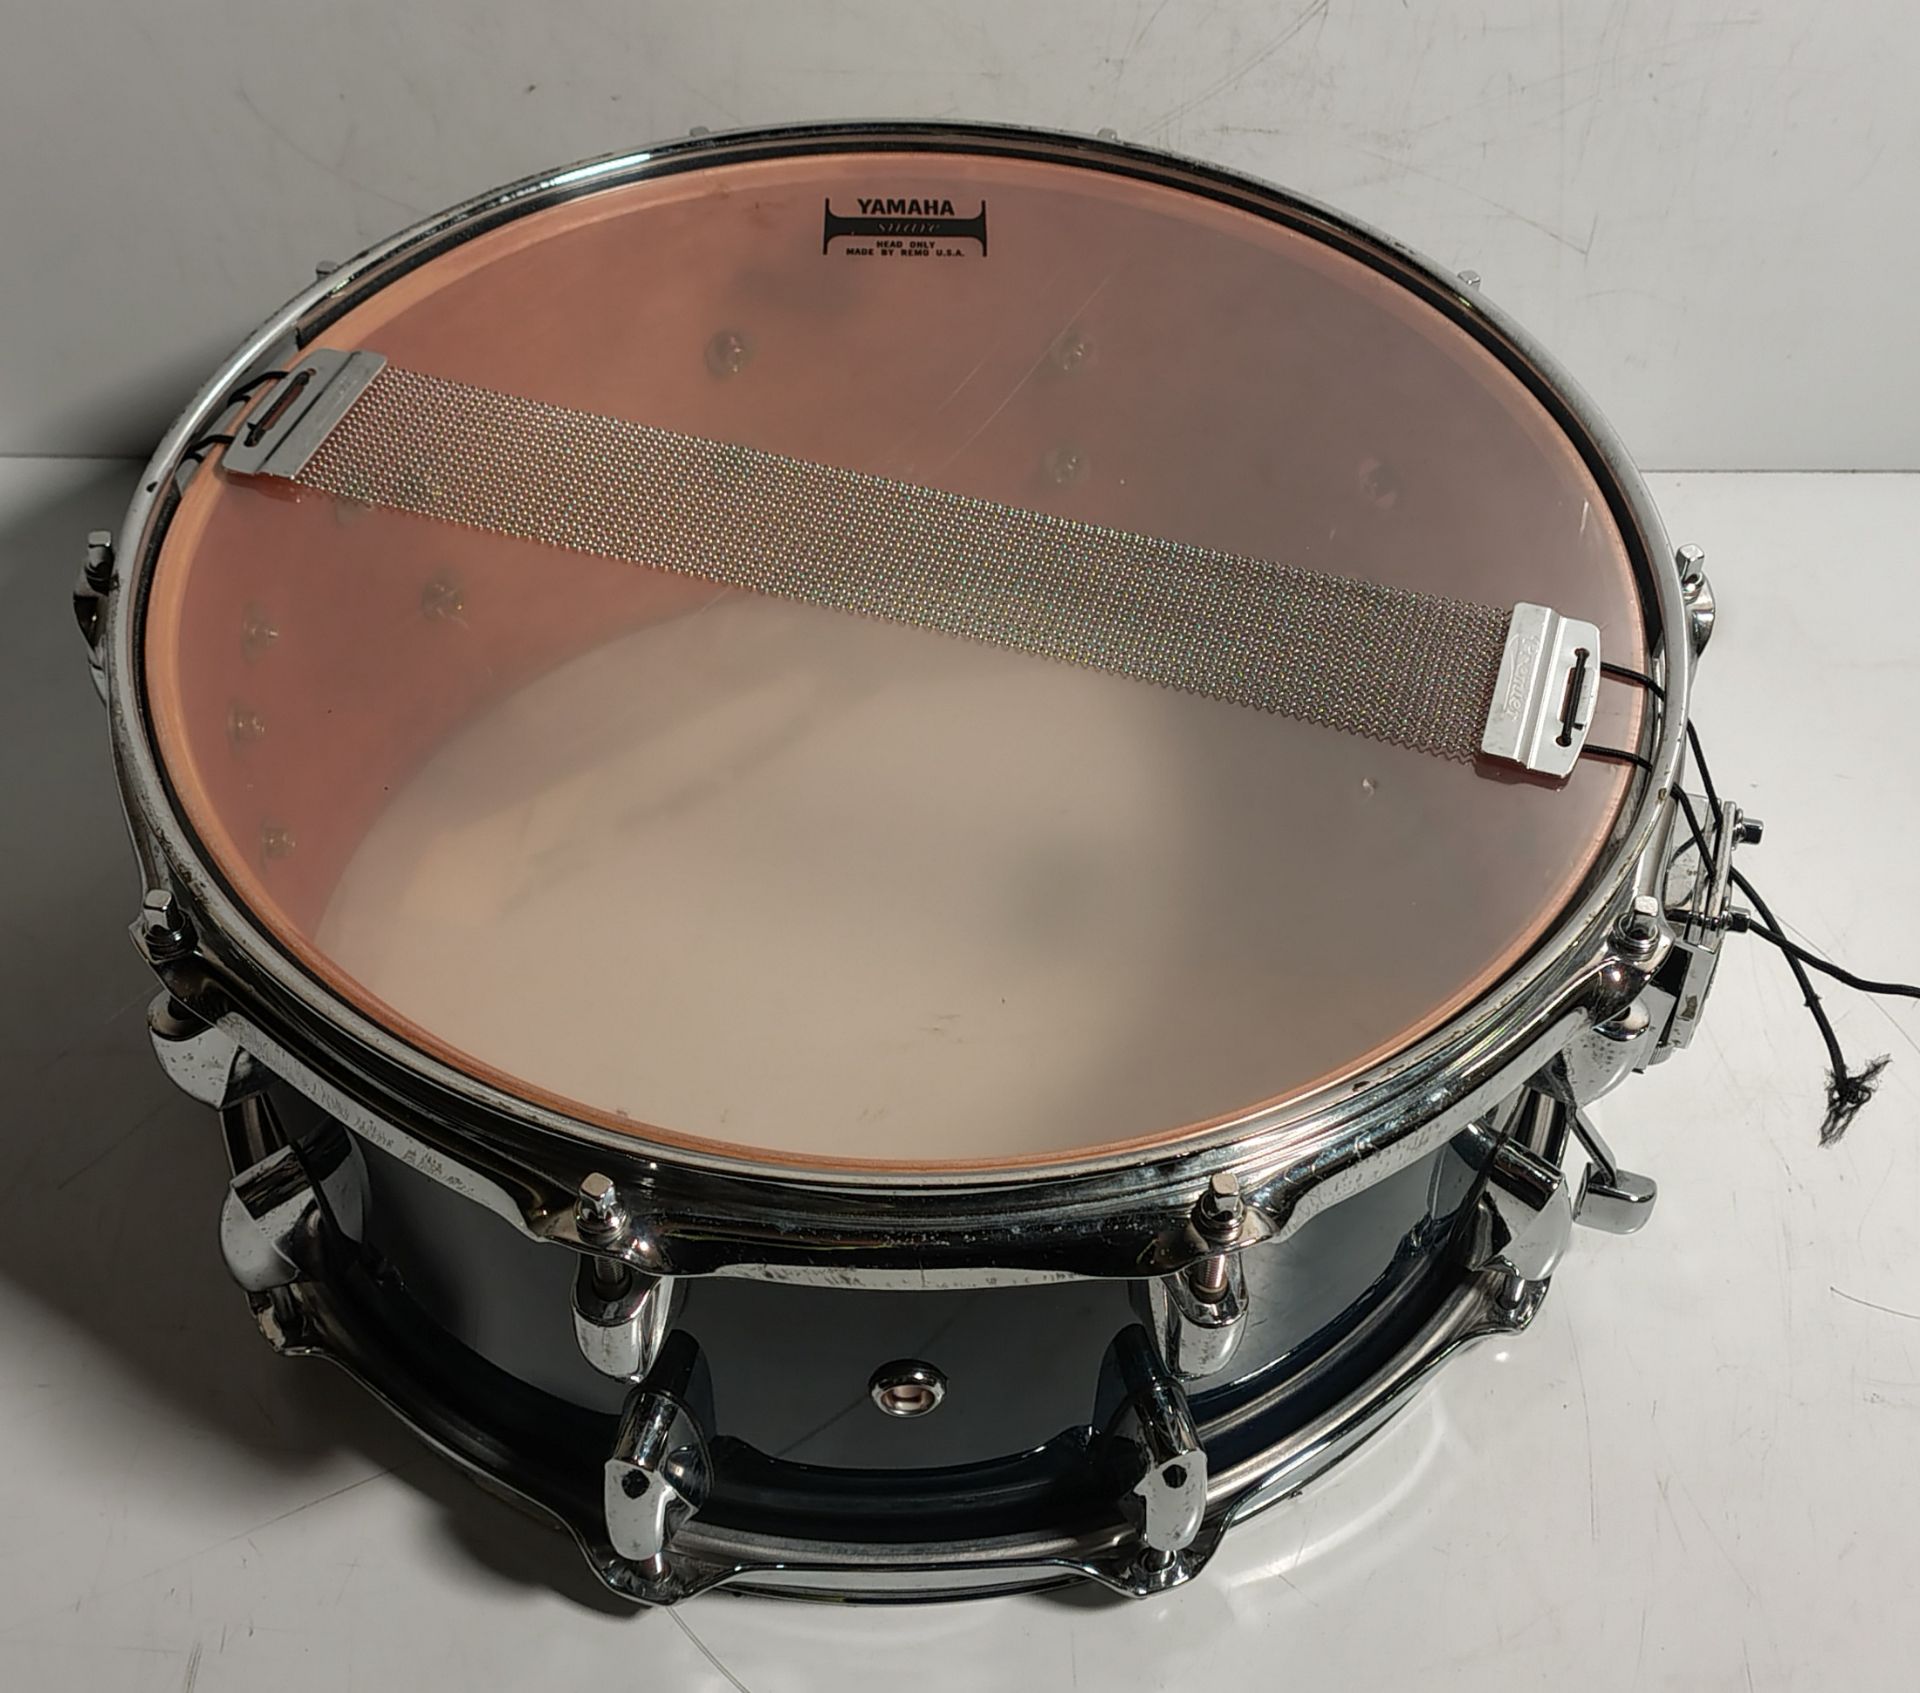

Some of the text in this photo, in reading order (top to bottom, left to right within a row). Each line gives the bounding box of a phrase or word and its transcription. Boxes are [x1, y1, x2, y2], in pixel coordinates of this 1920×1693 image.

[857, 199, 954, 215] YAMAHA
[910, 241, 935, 249] ONLY
[846, 248, 874, 256] MADE
[900, 249, 929, 257] REMO
[936, 249, 965, 257] U.S.A.
